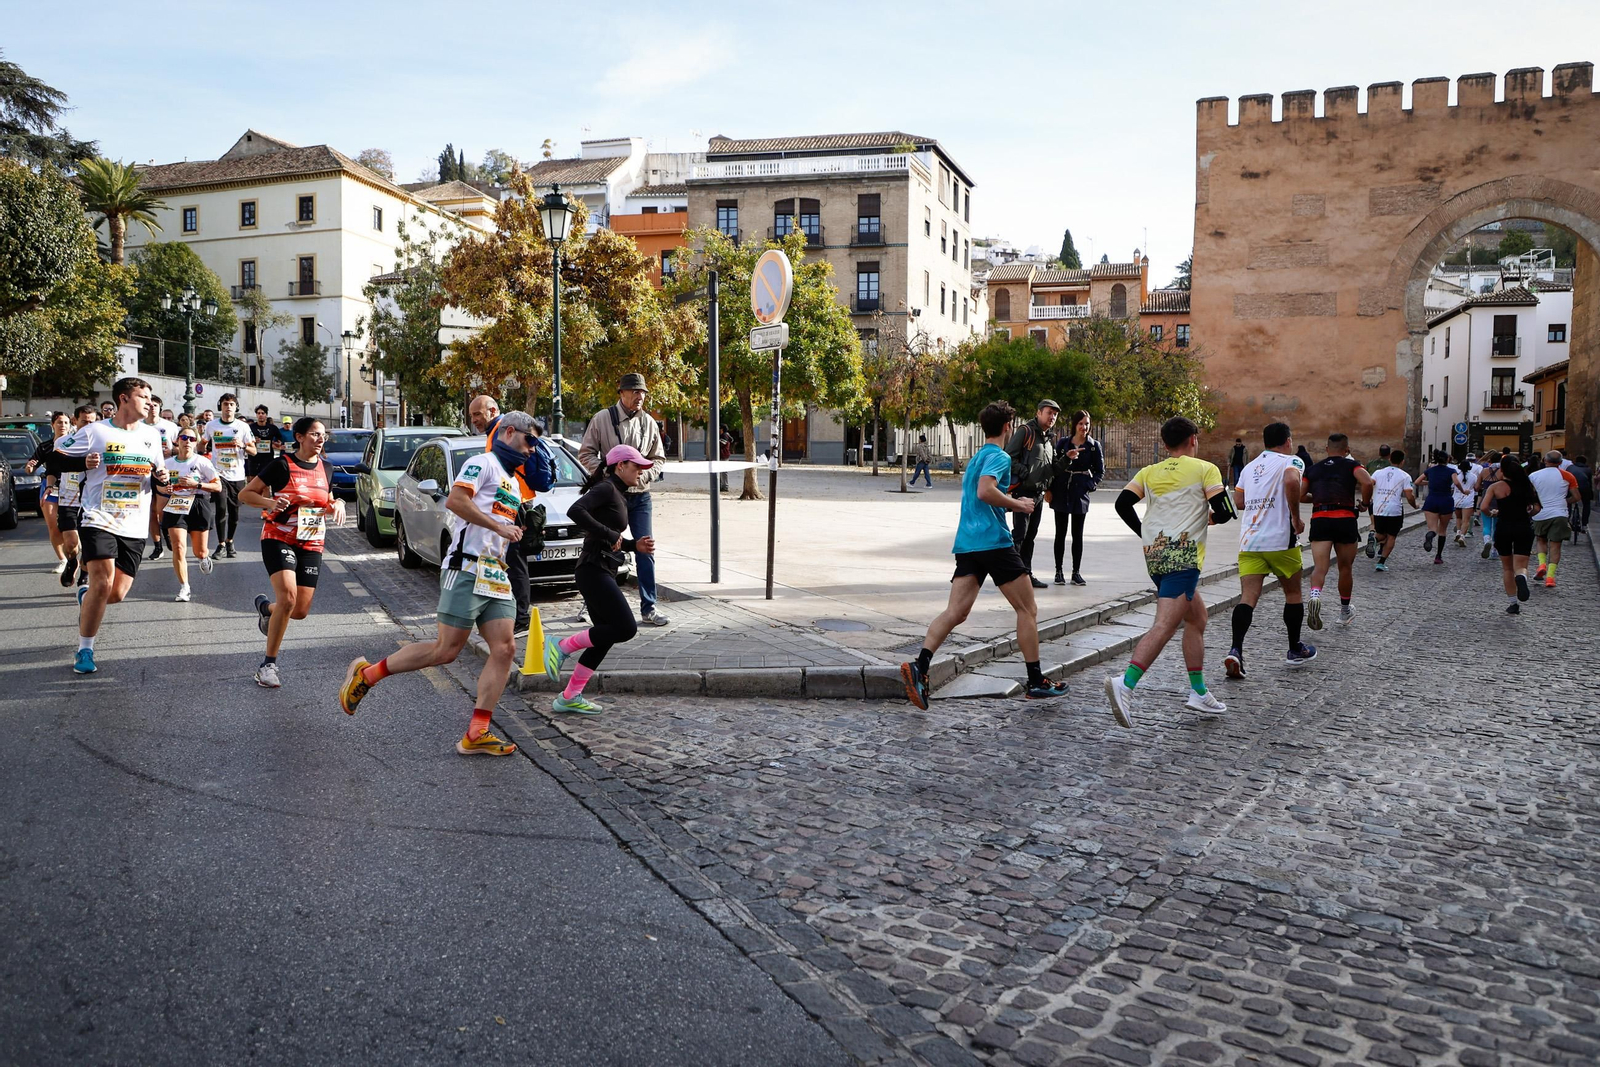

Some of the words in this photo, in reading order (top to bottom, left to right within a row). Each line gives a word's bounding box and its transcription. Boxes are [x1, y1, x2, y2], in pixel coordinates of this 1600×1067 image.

[106, 490, 137, 498] 1043
[542, 549, 566, 559] 0028
[484, 568, 506, 581] 546
